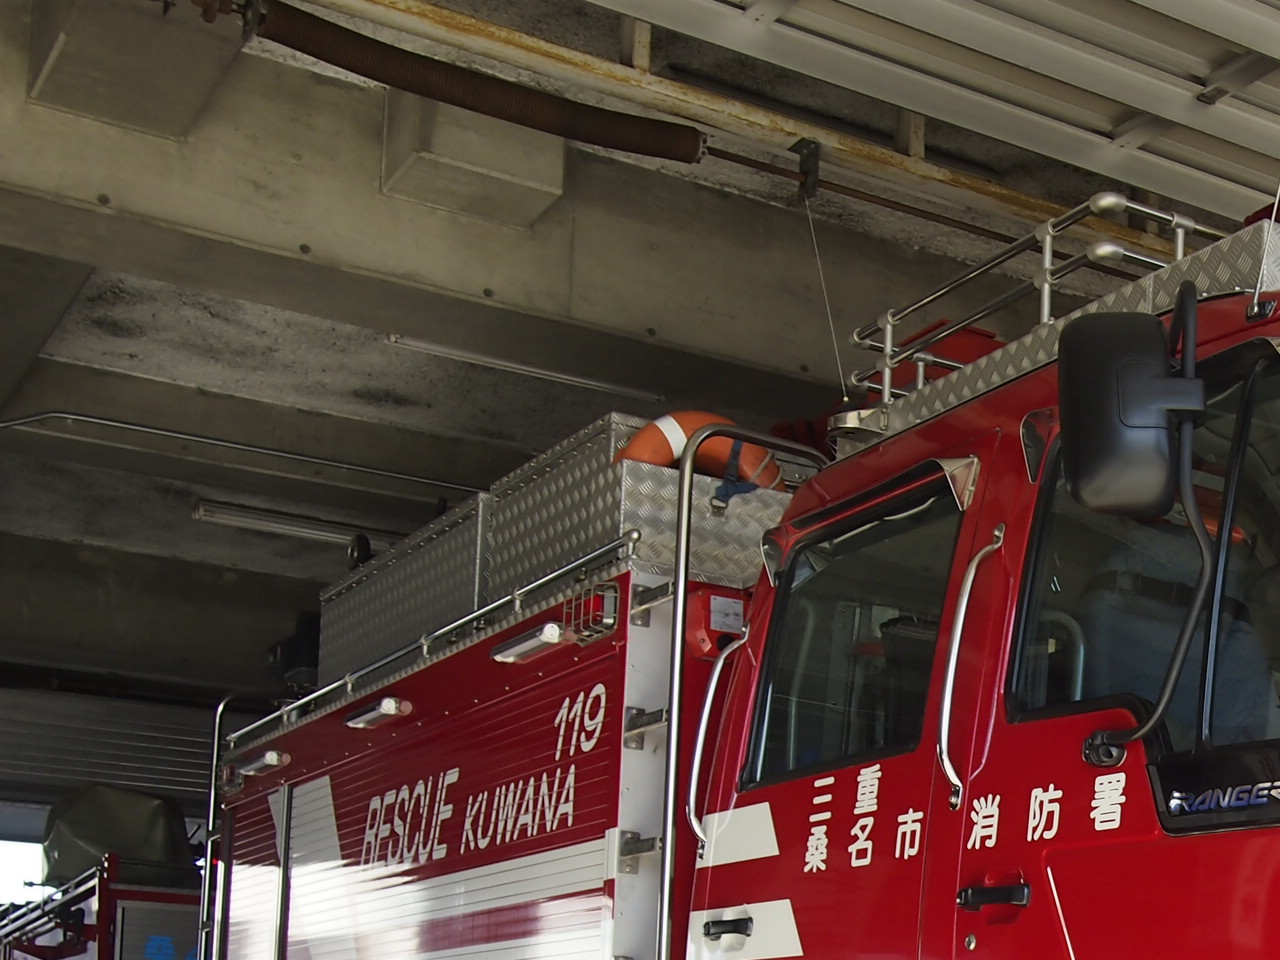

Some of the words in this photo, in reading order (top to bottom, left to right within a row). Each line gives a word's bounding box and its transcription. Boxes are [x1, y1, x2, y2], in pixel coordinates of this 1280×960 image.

[554, 682, 607, 762] 119
[362, 766, 460, 872] RESCUE
[459, 763, 576, 856] KUWANA
